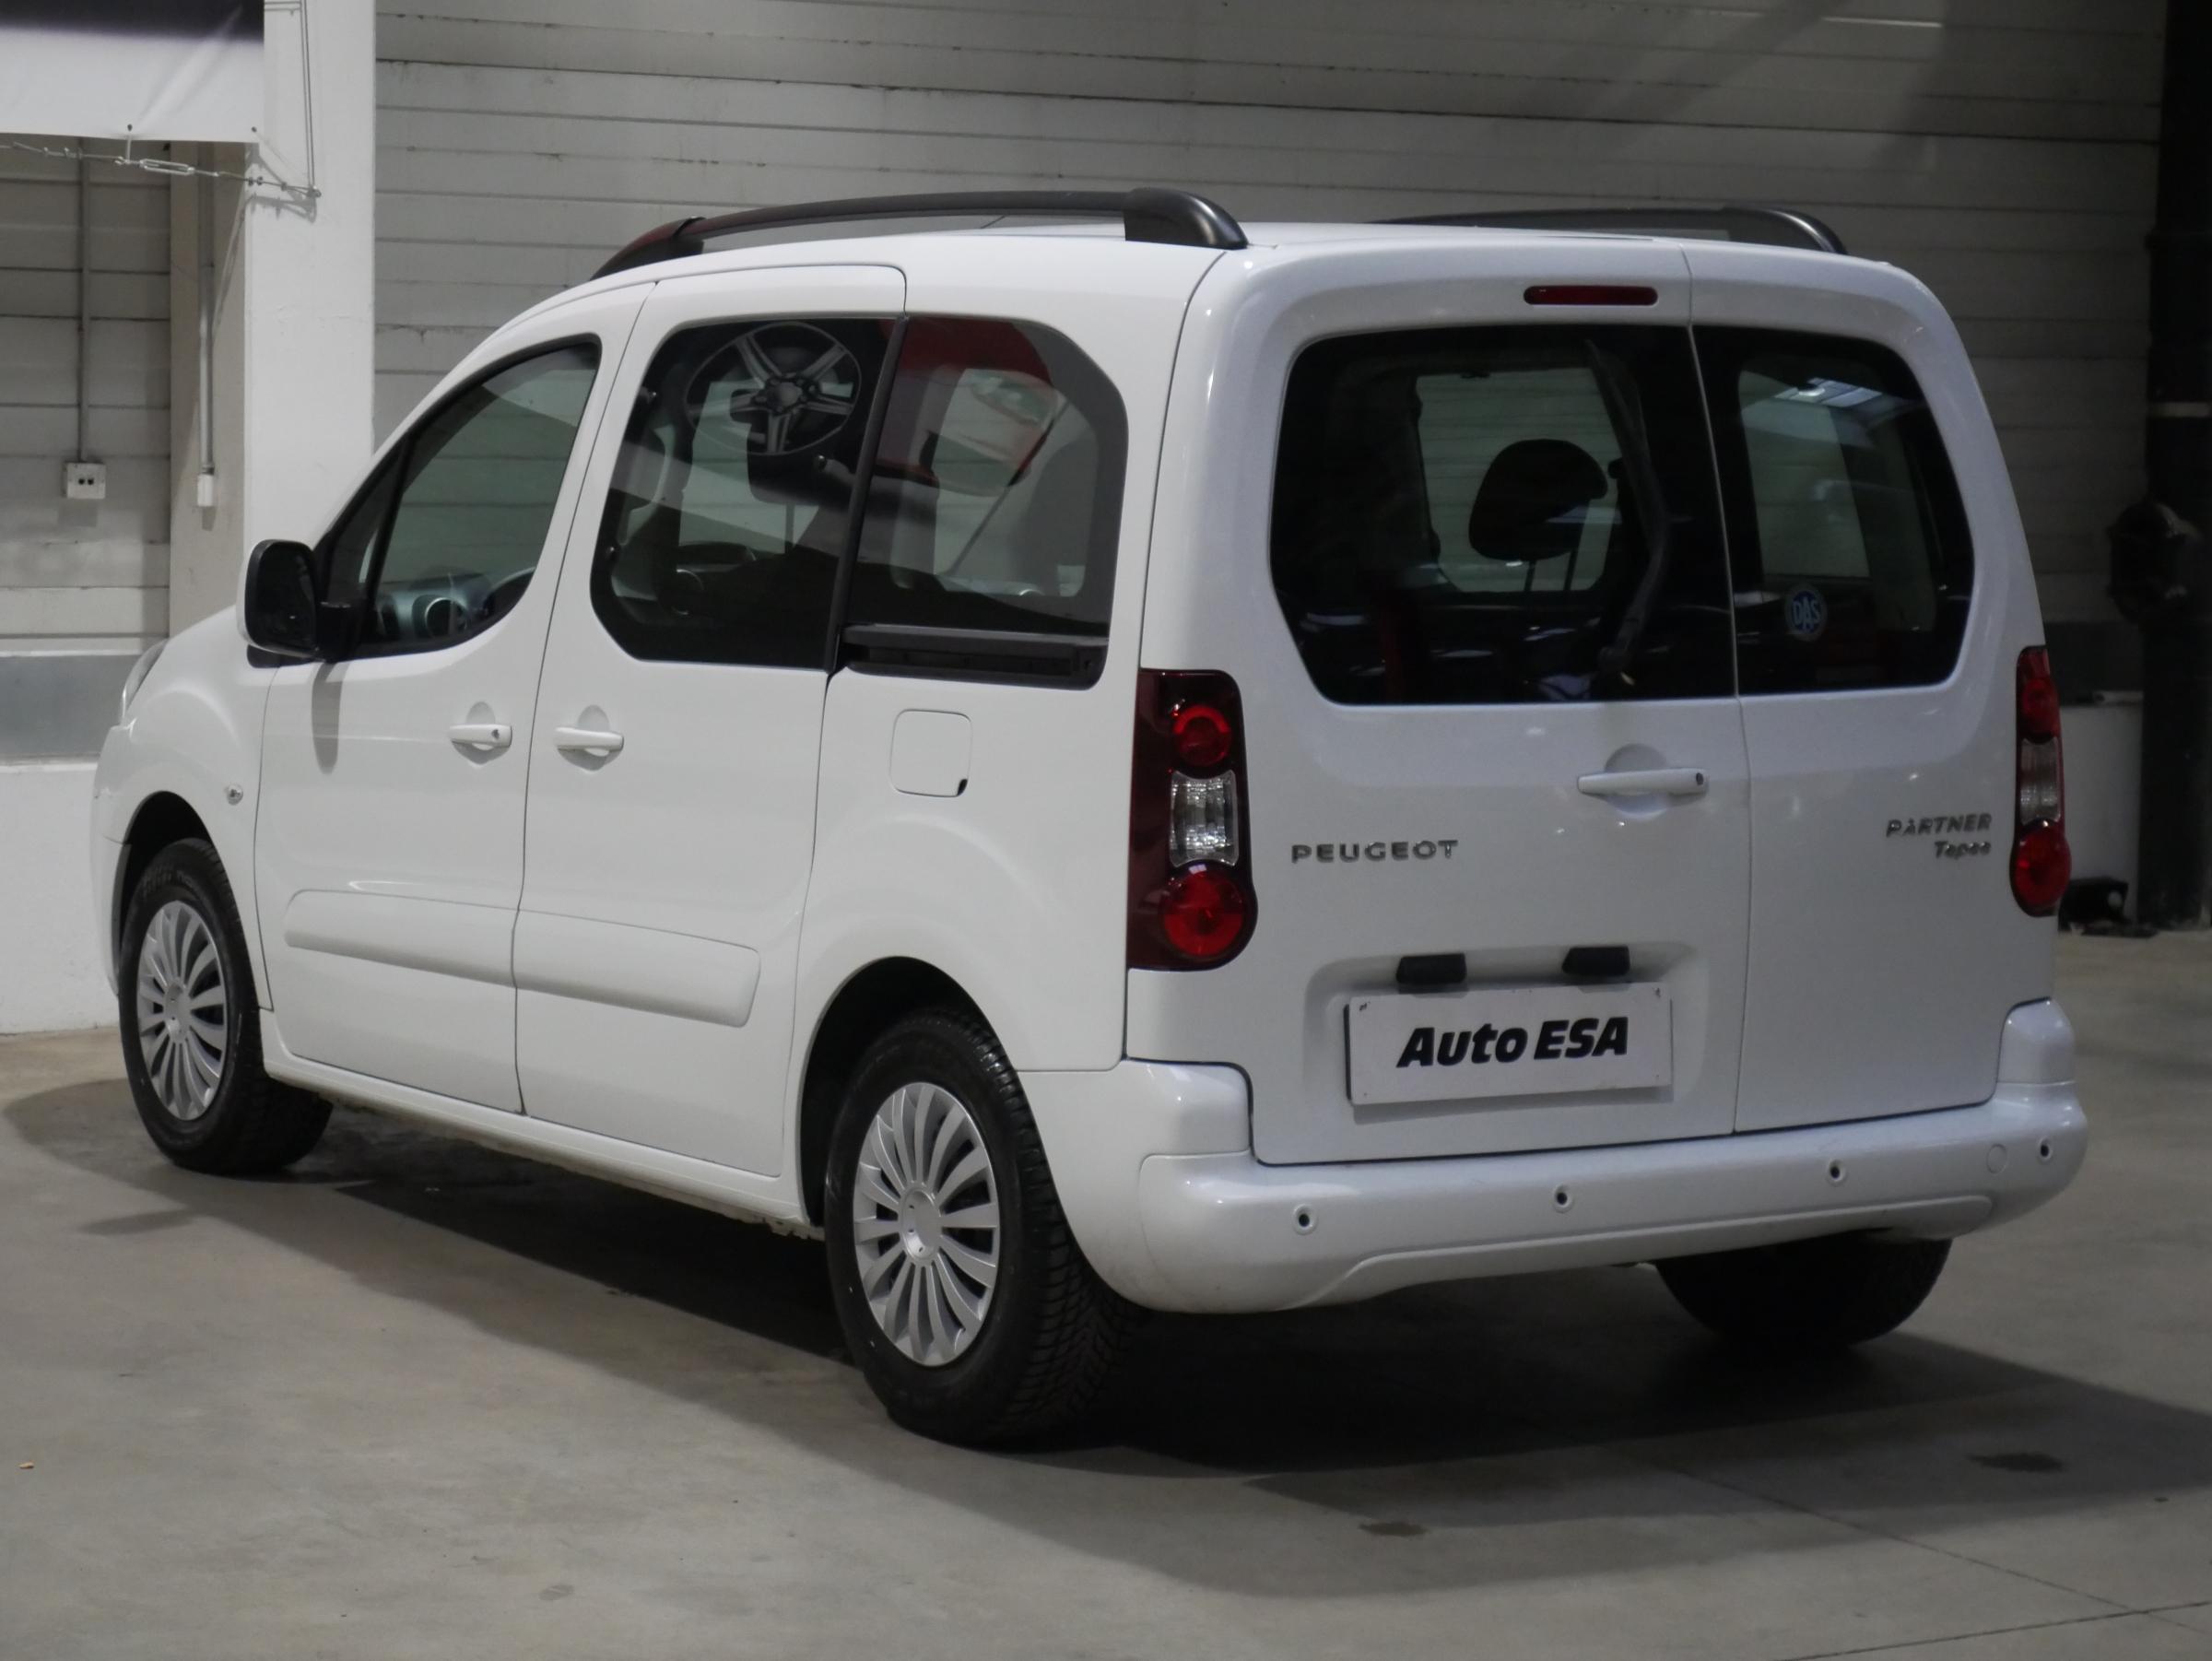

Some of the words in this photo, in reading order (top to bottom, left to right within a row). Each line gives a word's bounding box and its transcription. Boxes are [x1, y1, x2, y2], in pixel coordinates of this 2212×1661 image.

[1886, 813, 1992, 837] PARTNER
[1291, 840, 1458, 863] PEUGEOT
[1395, 1023, 1527, 1067] Auto
[1534, 1017, 1629, 1060] ESA
